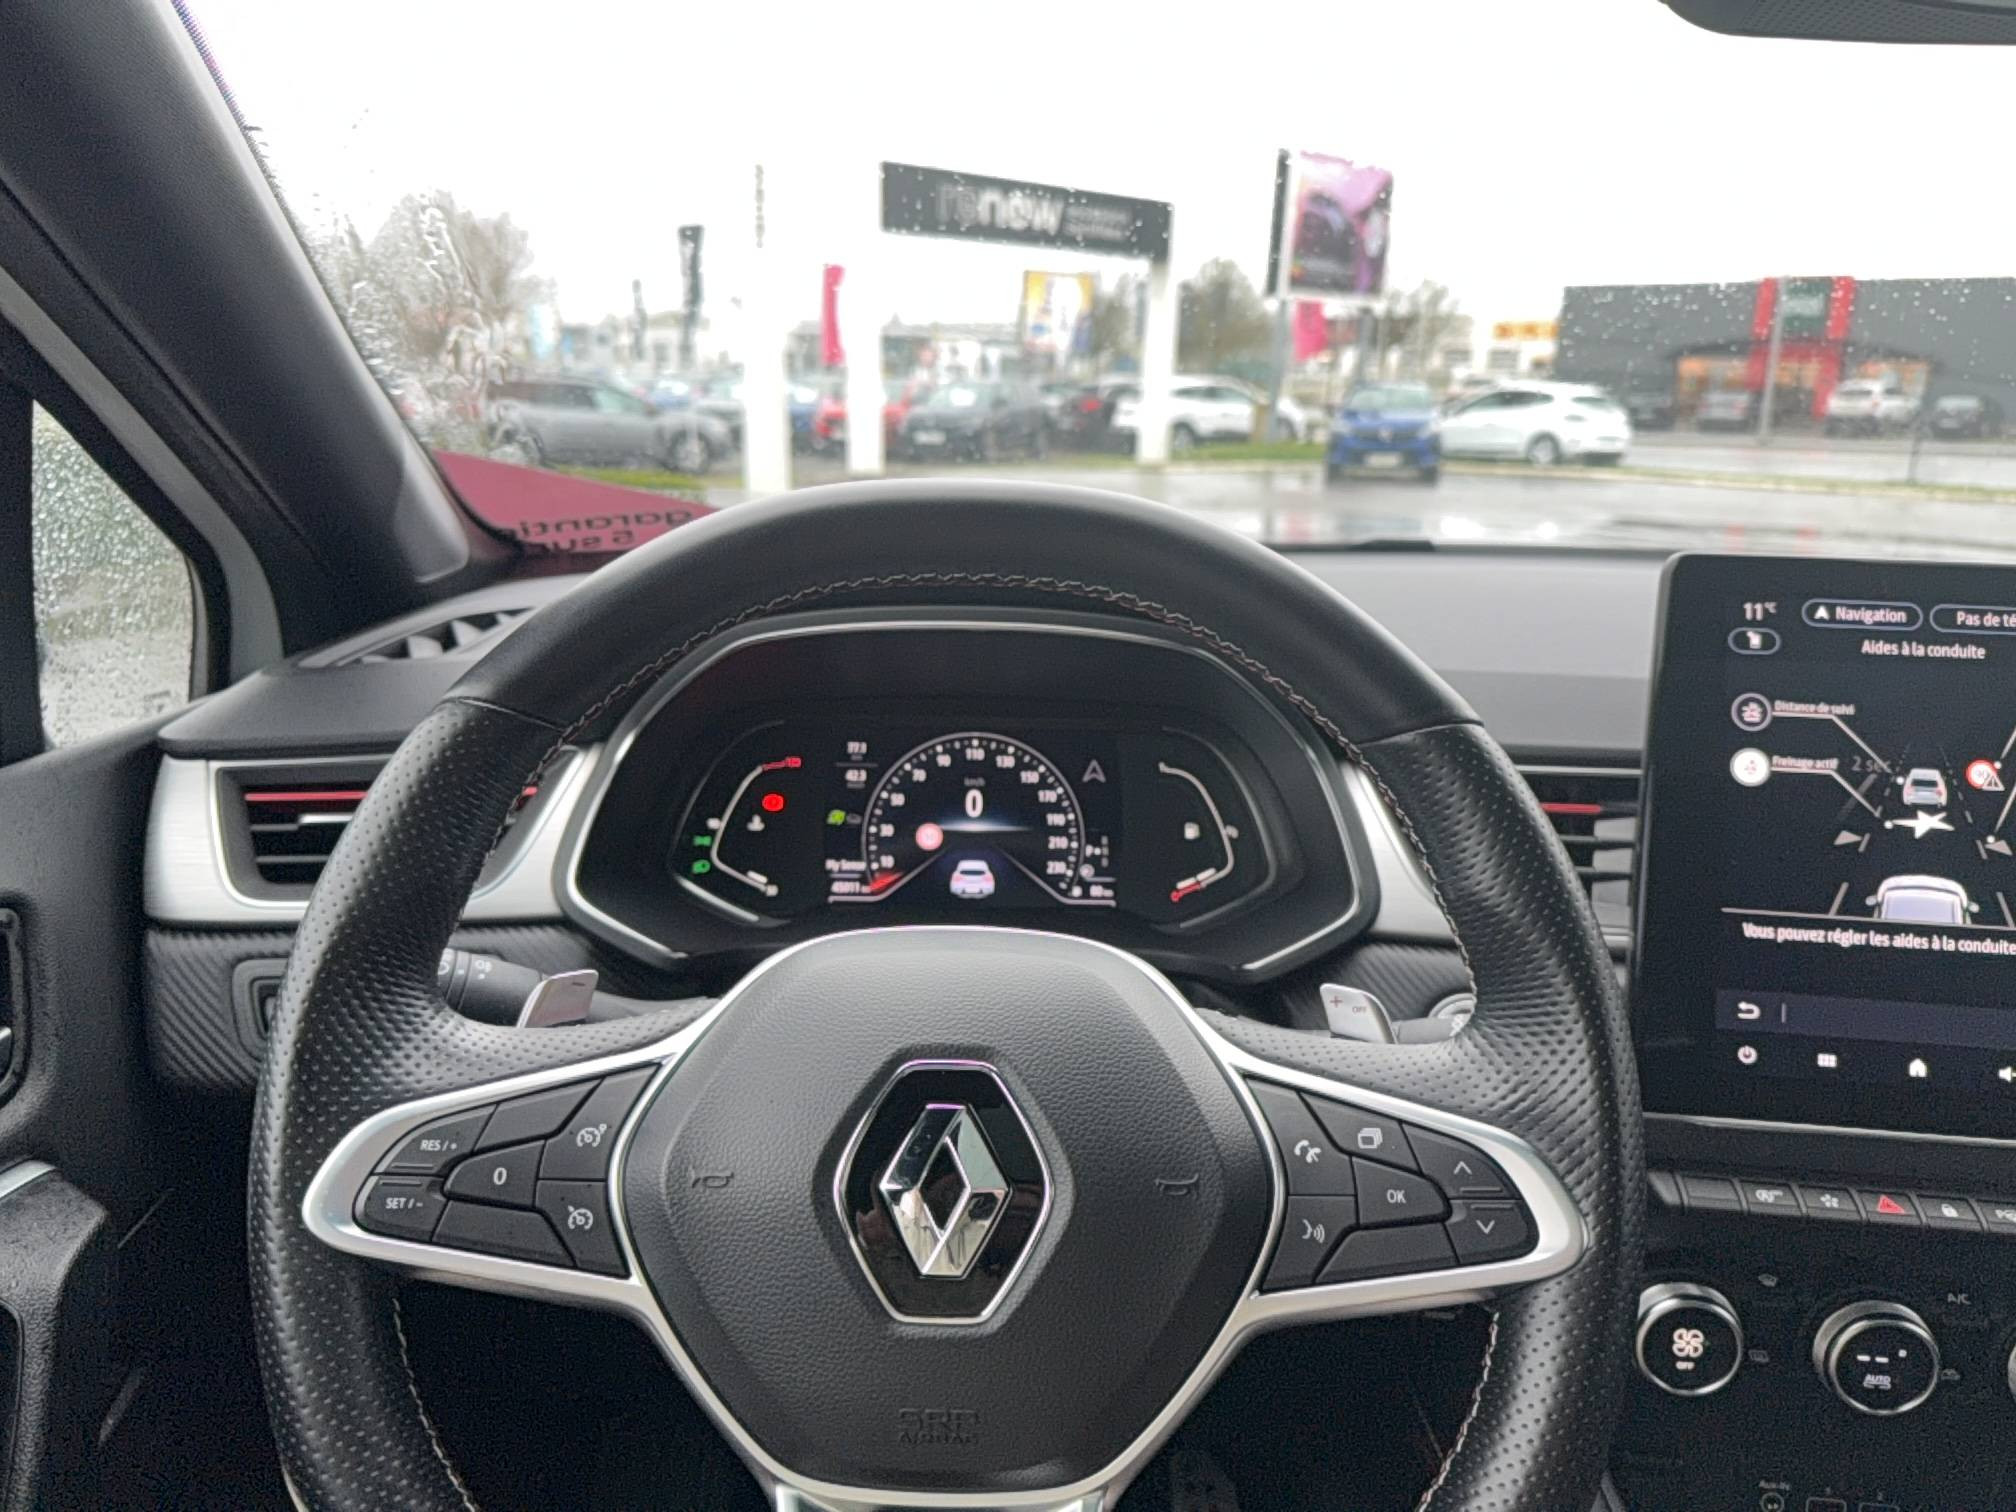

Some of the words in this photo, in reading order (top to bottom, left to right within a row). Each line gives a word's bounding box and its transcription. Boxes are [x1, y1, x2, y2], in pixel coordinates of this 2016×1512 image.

[1835, 606, 1907, 625] Navigation
[1956, 611, 1980, 626] Pas
[1983, 612, 2001, 627] de
[1861, 640, 1899, 655] Aides
[1901, 641, 1910, 656] à
[1911, 641, 1925, 657] la
[1927, 643, 1986, 659] conduite
[936, 754, 951, 767] 90
[965, 747, 985, 761] 110
[996, 755, 1015, 768] 130
[1852, 756, 1861, 771] 2
[912, 768, 927, 782] 70
[1020, 770, 1039, 784] 150
[890, 793, 905, 807] 50
[1038, 789, 1057, 803] 170
[965, 789, 983, 818] 0
[880, 823, 895, 837] 30
[1048, 836, 1069, 850] 210
[880, 855, 895, 868] 10
[1046, 861, 1066, 874] 230
[1742, 922, 1775, 939] Vous
[1776, 927, 1825, 943] pouvez
[1827, 928, 1868, 947] régler
[1869, 930, 1889, 947] les
[1891, 933, 1929, 949] aides
[1931, 934, 1941, 951] à
[1942, 935, 1956, 951] la
[1957, 938, 2016, 955] conduite
[493, 1167, 507, 1185] 0
[1387, 1189, 1406, 1203] OK
[1865, 1373, 1891, 1385] AUTO
